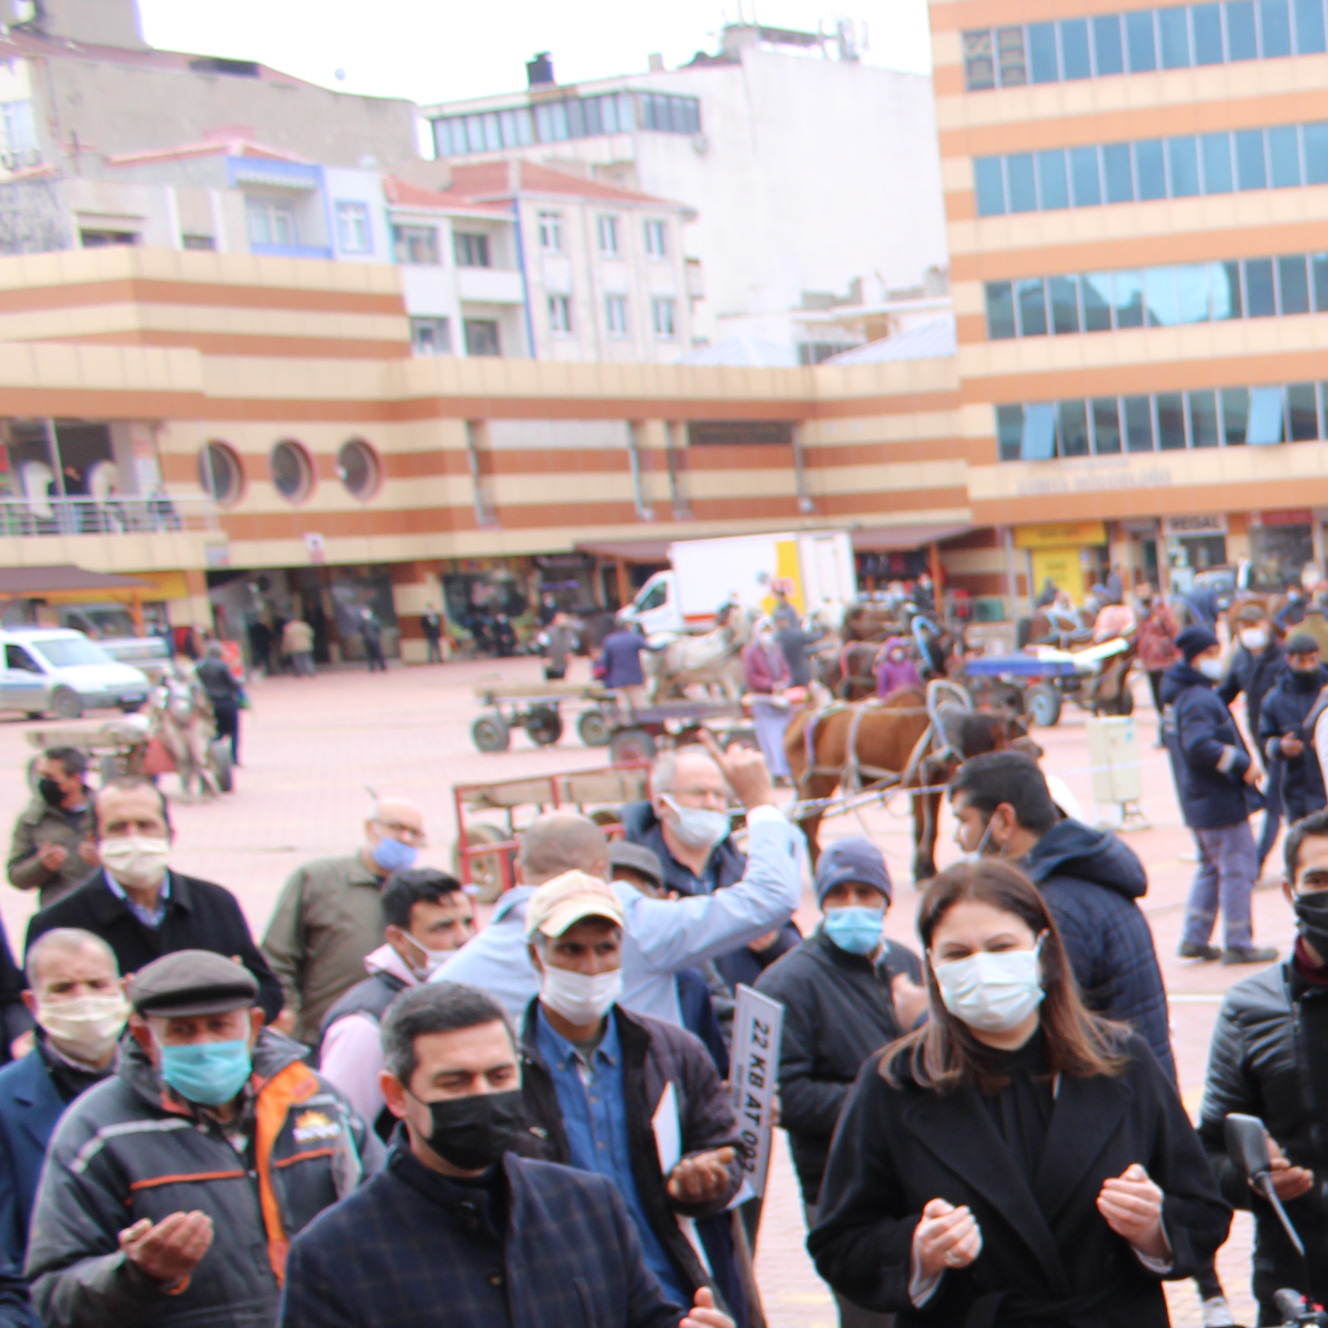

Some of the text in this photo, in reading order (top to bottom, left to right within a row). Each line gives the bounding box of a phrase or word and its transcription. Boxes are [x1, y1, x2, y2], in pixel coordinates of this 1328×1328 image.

[1170, 514, 1220, 530] REGAL
[752, 1017, 771, 1049] 22
[748, 1054, 767, 1089] KB
[744, 1093, 763, 1127] AT
